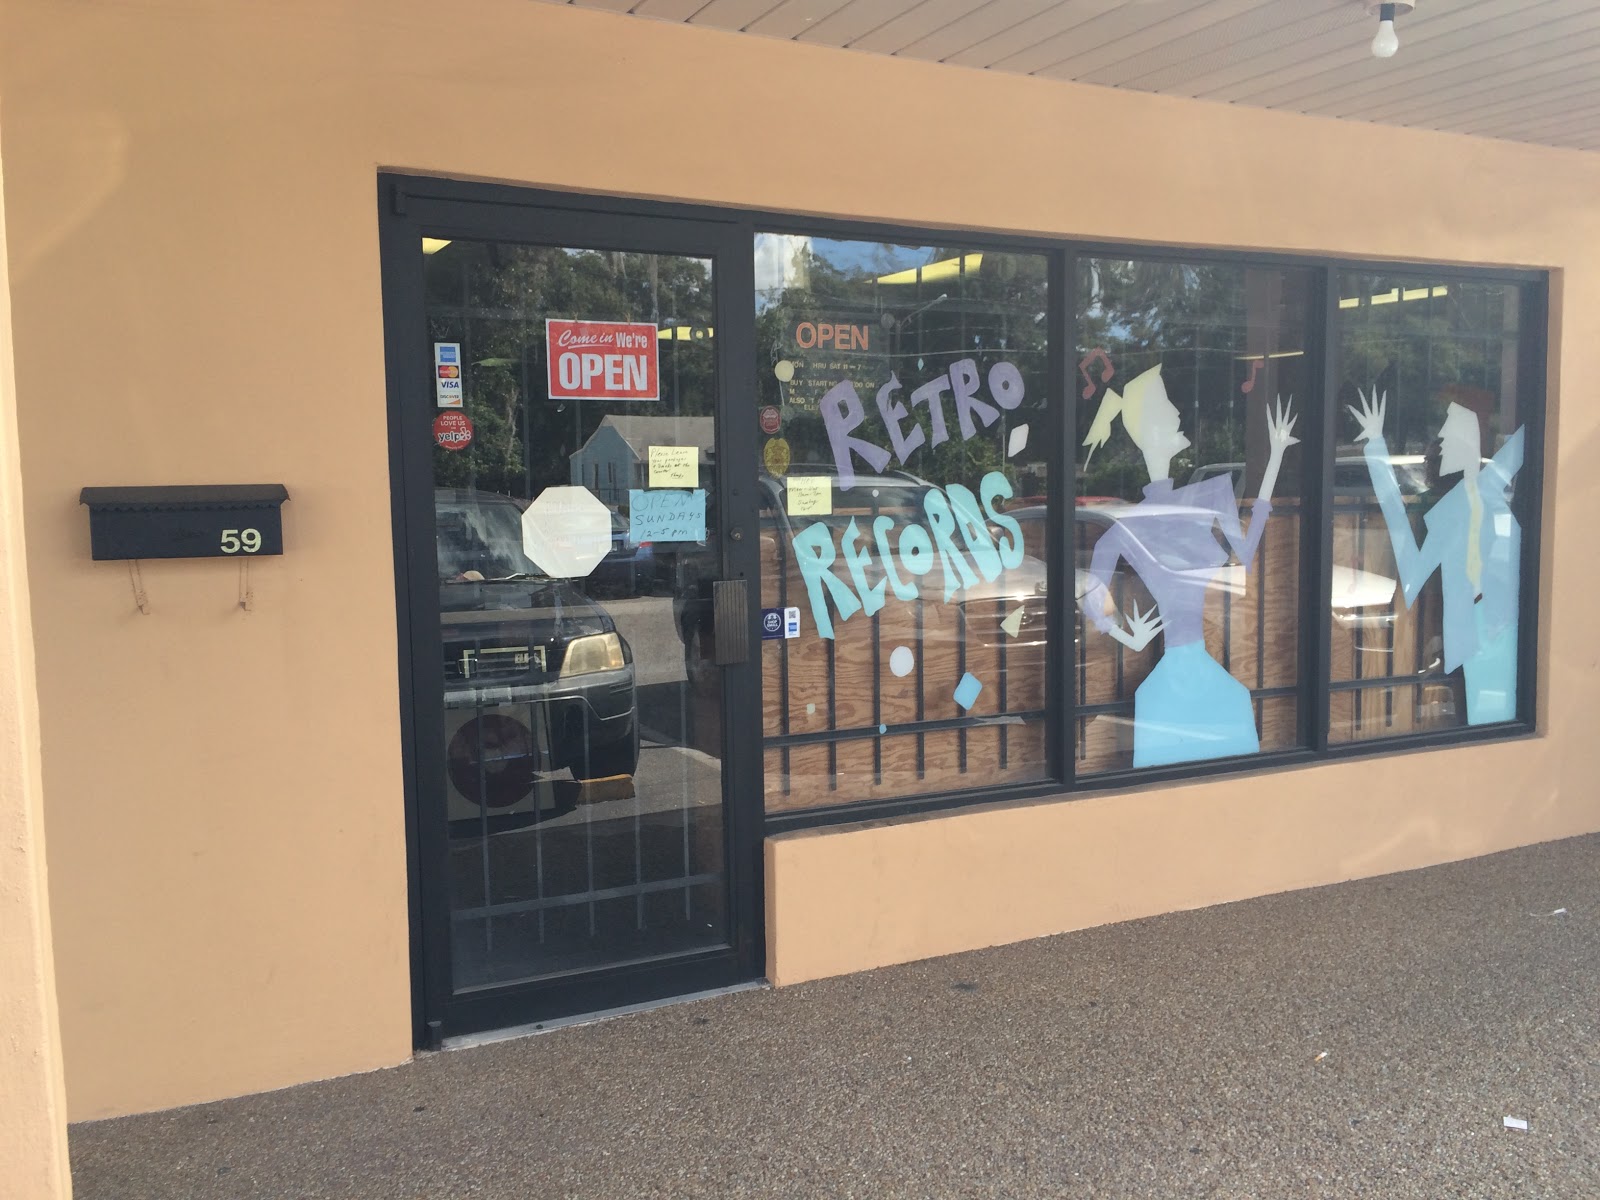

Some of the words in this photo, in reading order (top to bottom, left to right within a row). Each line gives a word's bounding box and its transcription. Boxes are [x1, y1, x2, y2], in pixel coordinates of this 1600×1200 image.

[558, 329, 598, 347] Come
[599, 332, 614, 343] in
[615, 331, 648, 349] We're
[796, 322, 869, 351] OPEN
[558, 352, 648, 391] OPEN
[441, 381, 460, 389] VISA
[437, 430, 461, 444] yelp
[820, 358, 1025, 492] RETRO
[631, 493, 693, 512] OPEN
[220, 528, 262, 553] 59
[792, 471, 1024, 640] RECORDS
